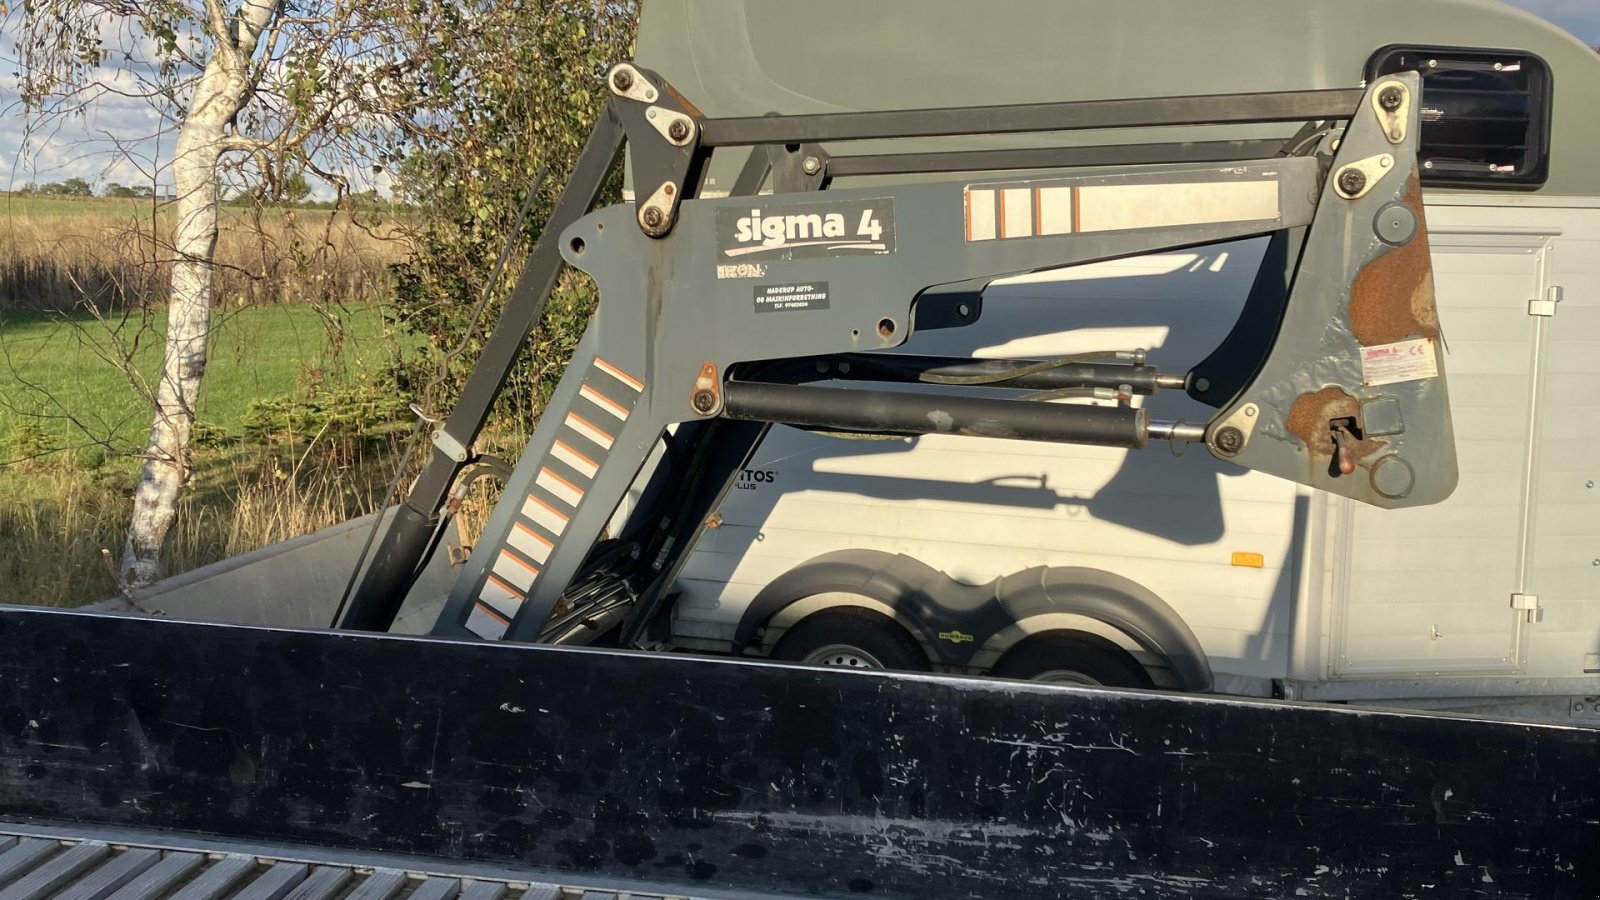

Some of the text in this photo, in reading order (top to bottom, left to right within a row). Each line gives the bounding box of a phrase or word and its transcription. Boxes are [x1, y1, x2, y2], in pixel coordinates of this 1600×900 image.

[735, 209, 882, 247] sigma 4
[741, 470, 775, 482] ITOS
